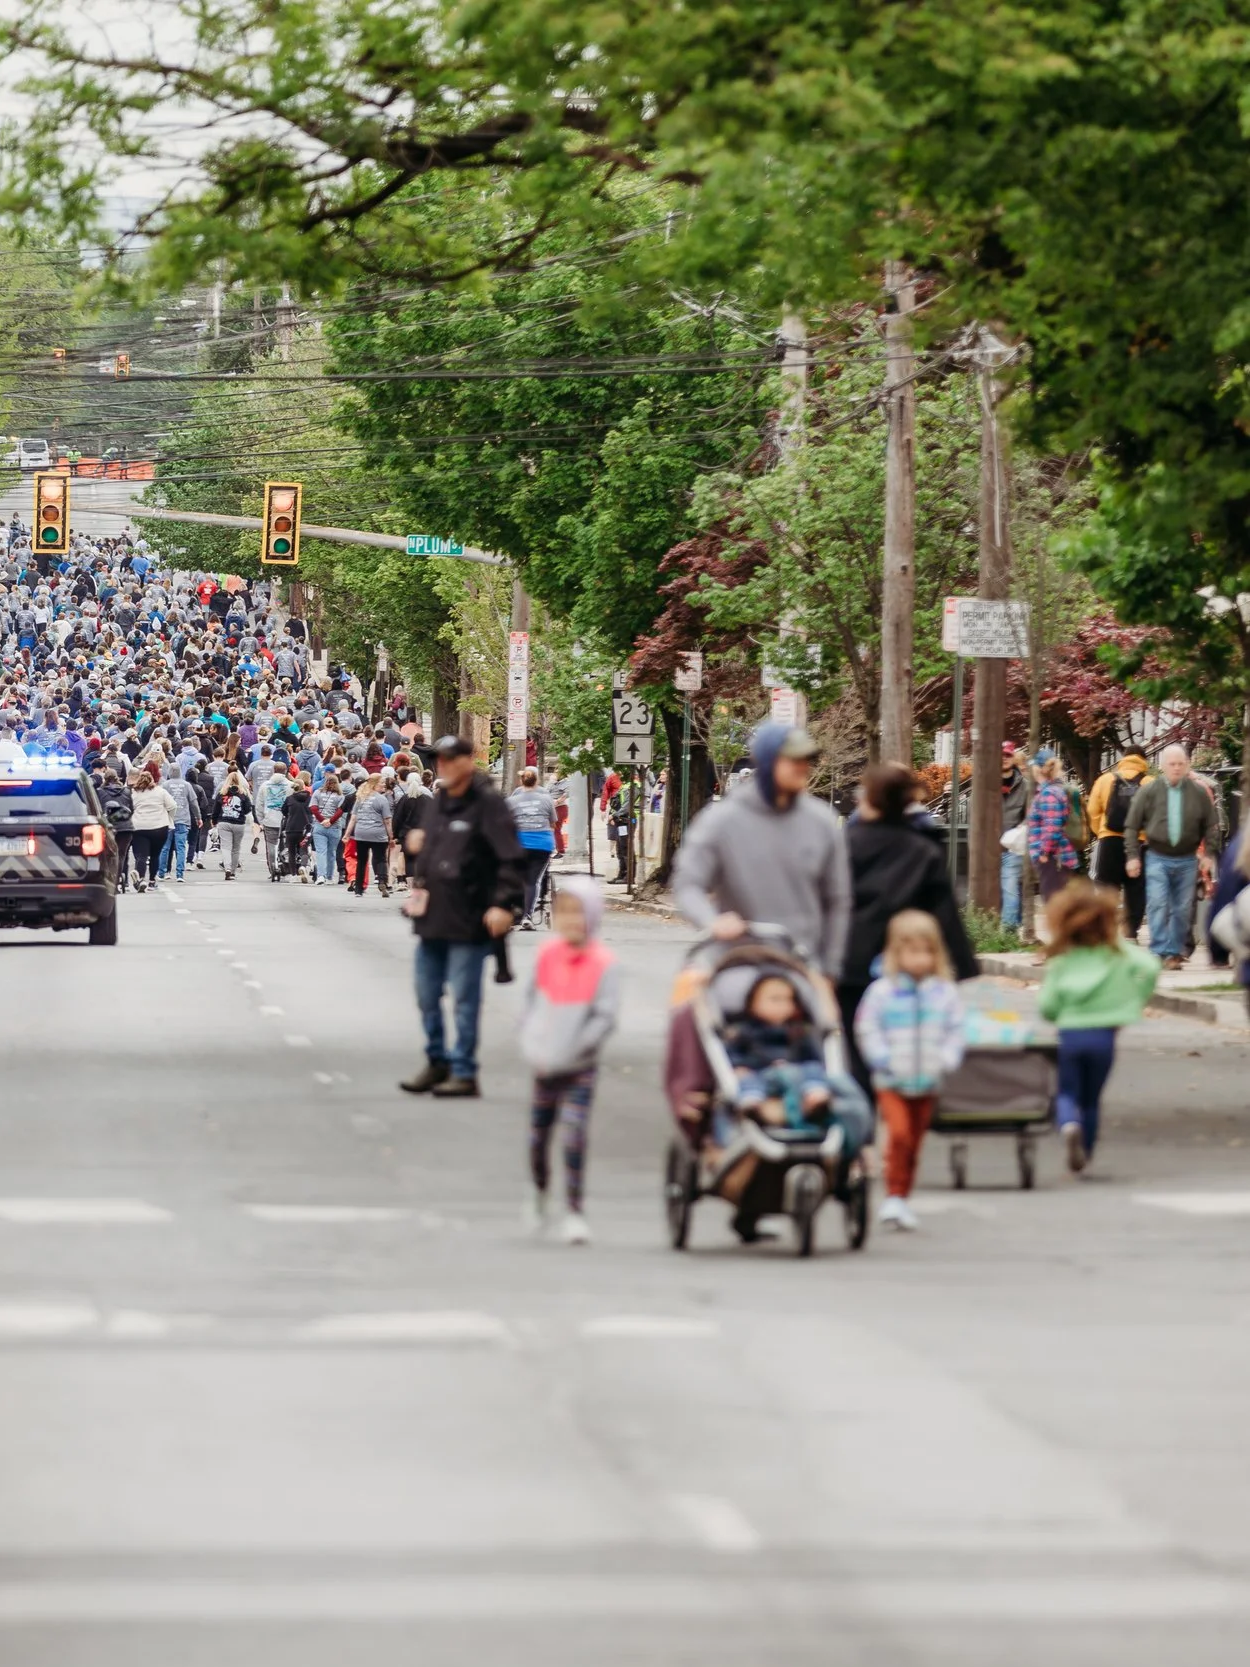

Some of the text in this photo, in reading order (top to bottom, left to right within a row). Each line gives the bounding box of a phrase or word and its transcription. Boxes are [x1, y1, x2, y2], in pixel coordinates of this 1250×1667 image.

[416, 537, 451, 553] PLUM
[963, 611, 990, 621] PERMIT
[620, 702, 650, 726] 23
[65, 837, 81, 847] 30
